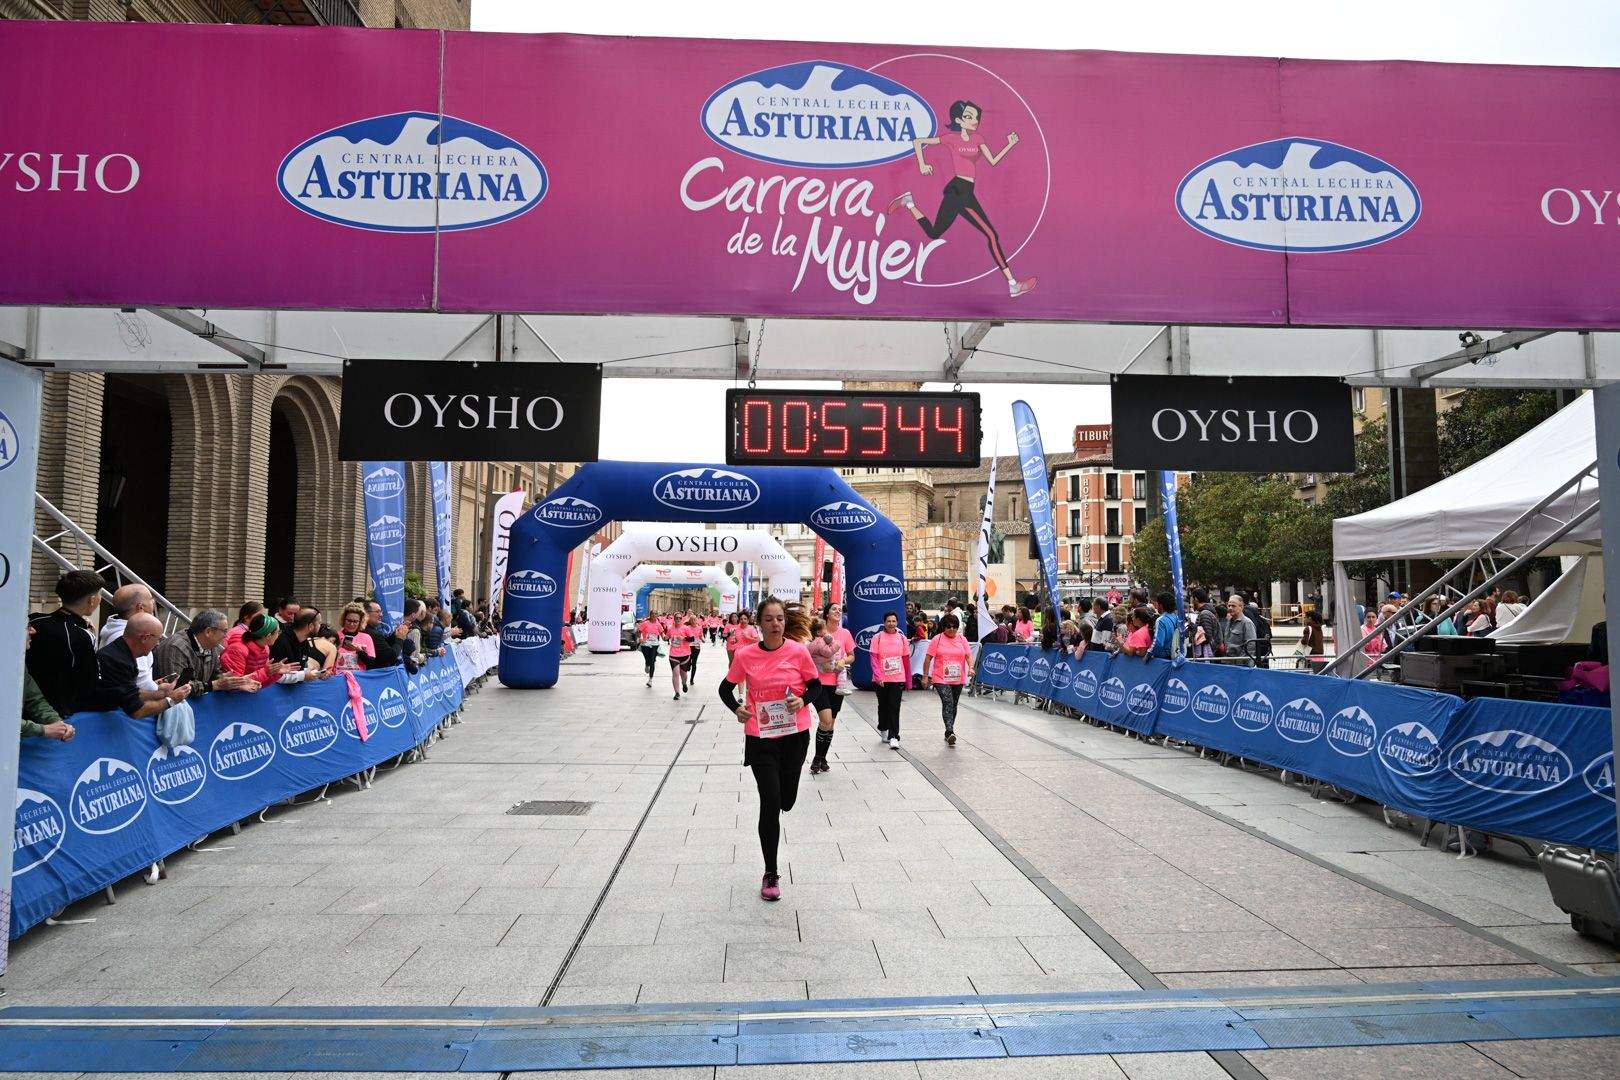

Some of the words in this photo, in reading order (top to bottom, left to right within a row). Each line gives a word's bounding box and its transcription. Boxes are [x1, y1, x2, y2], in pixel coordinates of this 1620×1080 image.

[756, 96, 830, 109] CENTRAL
[838, 98, 912, 111] LECHERA
[719, 97, 918, 142] ASTURIANA
[342, 153, 424, 165] CENTRAL
[435, 154, 519, 166] LECHERA
[298, 155, 527, 202] ASTURIANA
[680, 156, 874, 216] Carrera
[1233, 176, 1309, 188] CENTRAL
[1317, 177, 1394, 189] LECHERA
[1195, 178, 1404, 223] ASTURIANA
[1541, 188, 1620, 226] OY
[727, 216, 763, 255] de
[771, 216, 798, 256] la
[792, 213, 947, 305] Mujer
[384, 392, 565, 431] OYSHO
[1151, 408, 1319, 443] OYSHO
[1078, 430, 1109, 441] TIBUR
[661, 481, 752, 501] ASTURIANA
[538, 507, 597, 520] ASTURIANA
[816, 513, 873, 524] ASTURIANA
[656, 535, 738, 553] OYSHO
[1234, 703, 1270, 724] ASTURIANA
[1278, 711, 1320, 734] ASTURIANA
[285, 724, 336, 750] ASTURIANA
[215, 742, 273, 772] ASTURIANA
[1456, 749, 1561, 783] ASTURIANA
[152, 764, 204, 794] ASTURIANA
[79, 783, 145, 825] ASTURIANA
